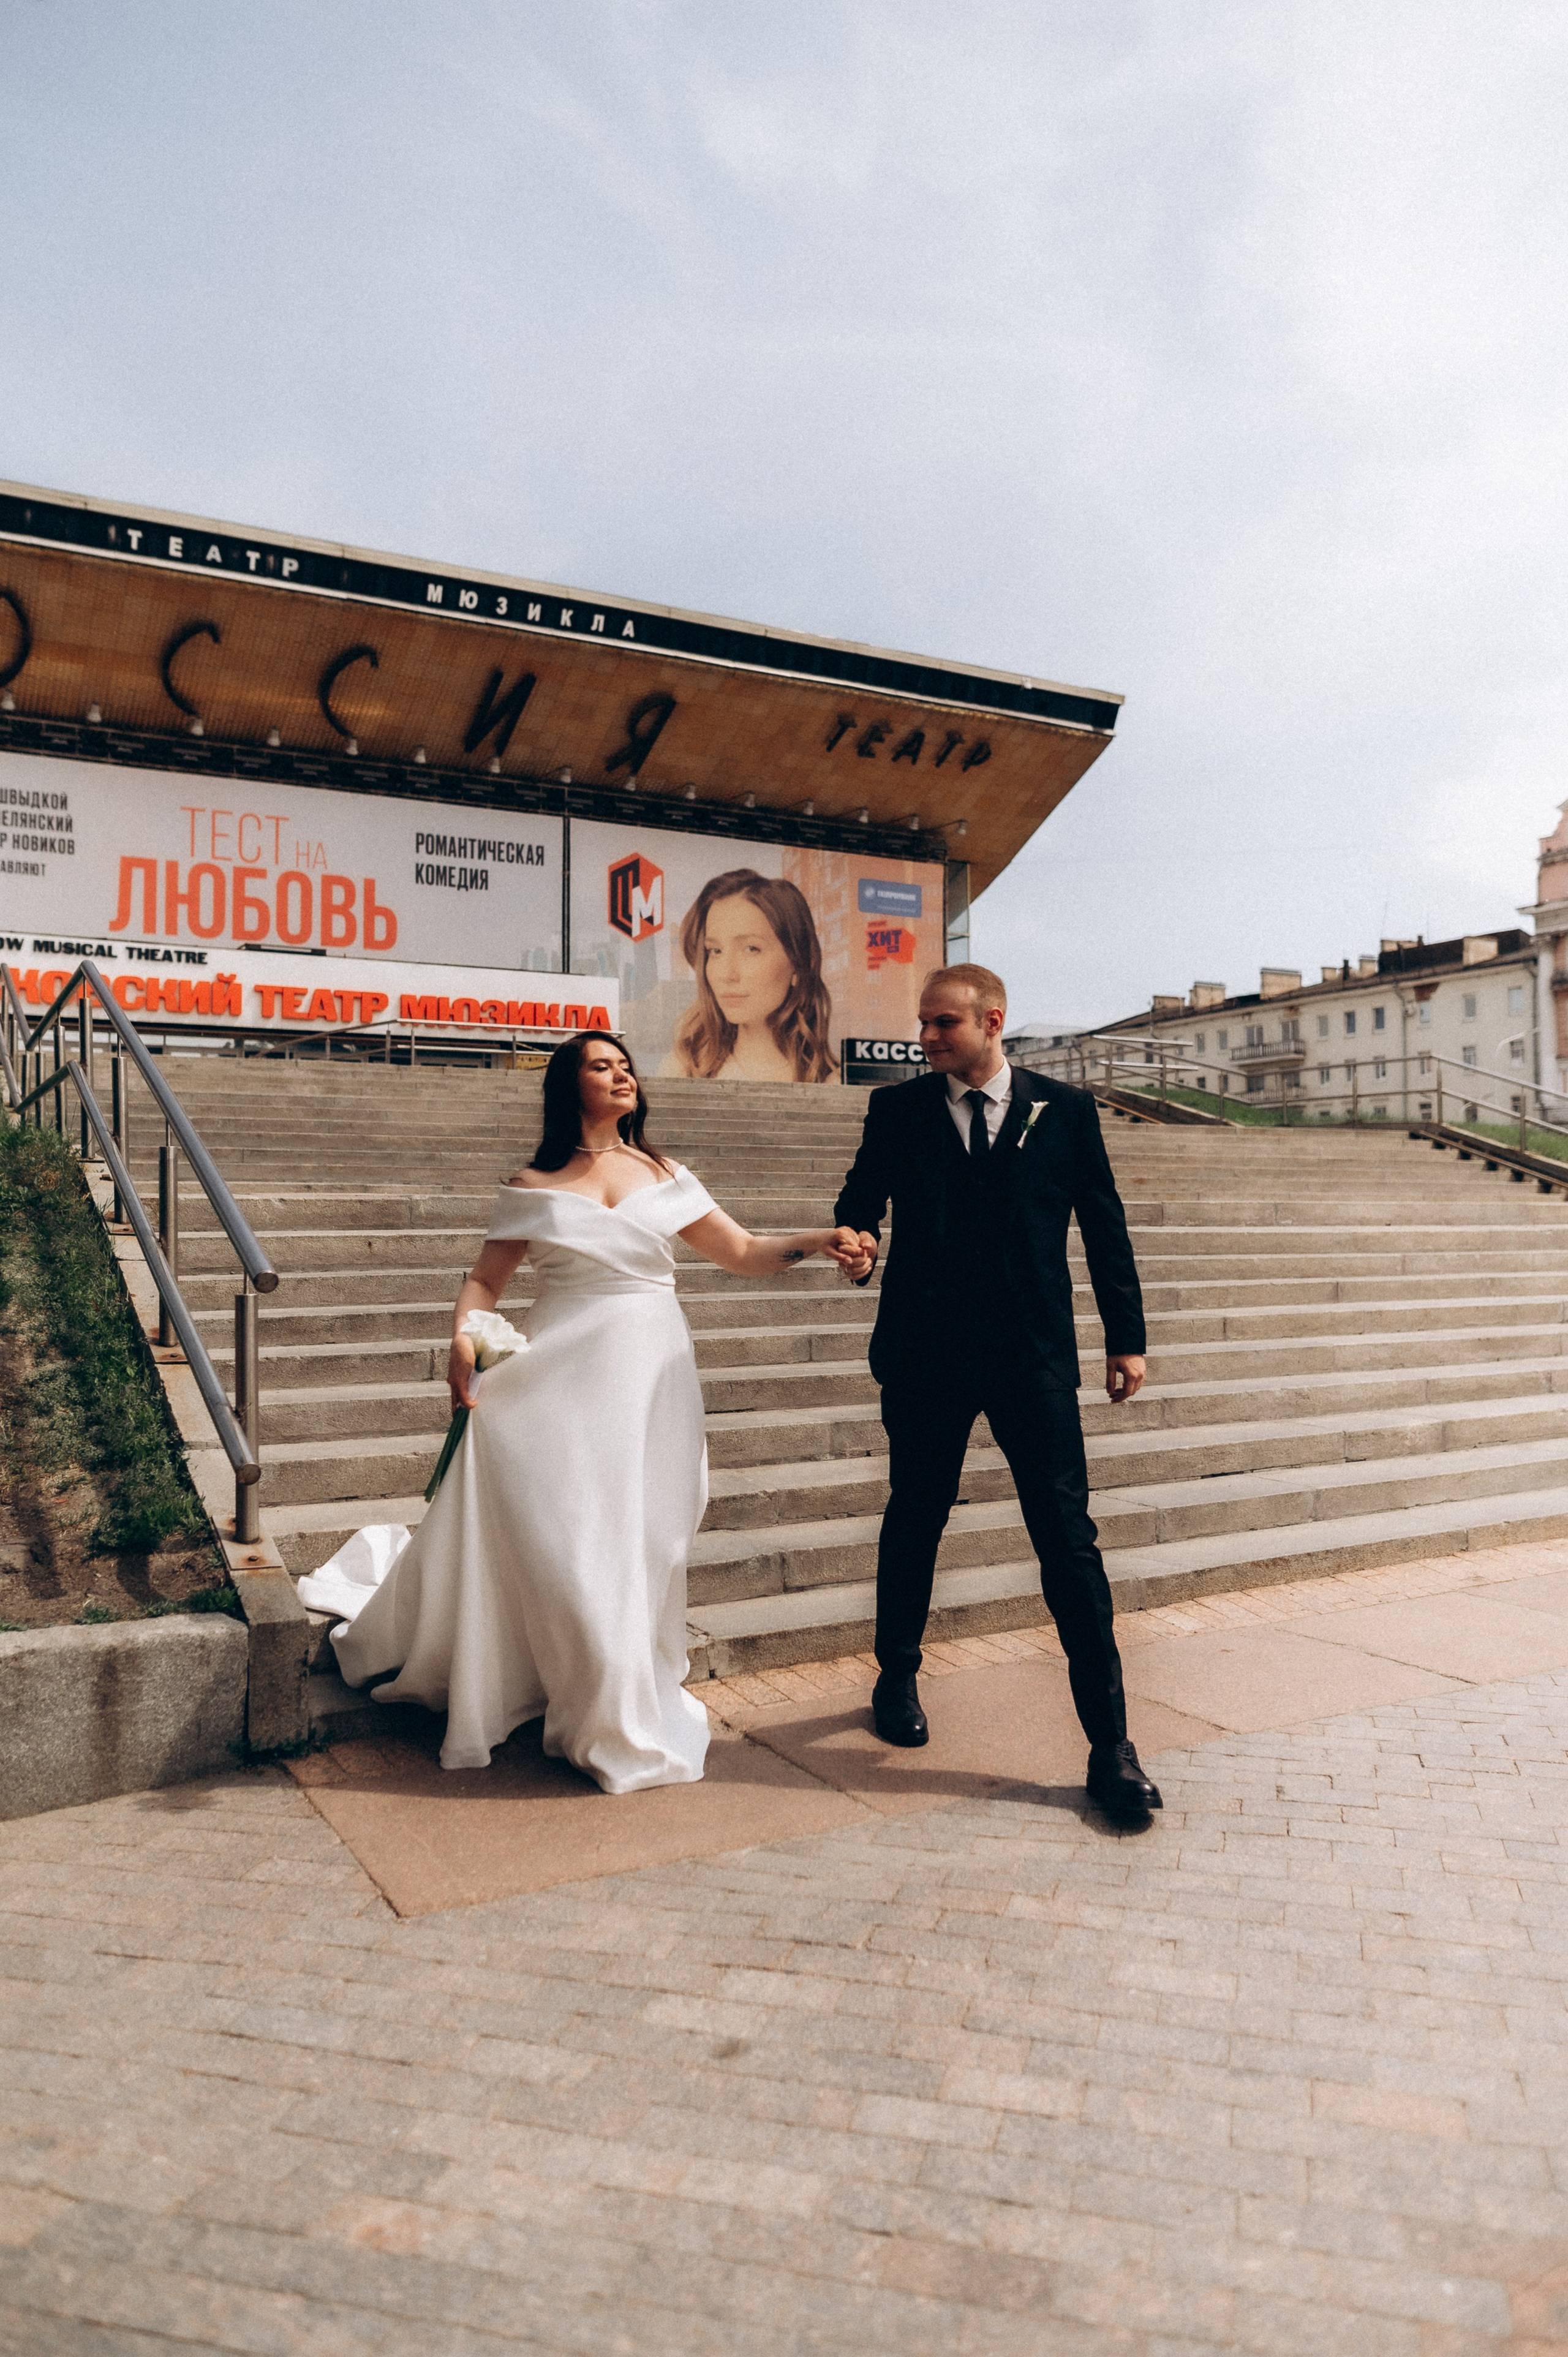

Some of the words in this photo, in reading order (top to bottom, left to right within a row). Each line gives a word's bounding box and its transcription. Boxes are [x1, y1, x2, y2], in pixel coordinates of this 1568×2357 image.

[127, 529, 299, 578] ТЕАТР
[427, 583, 635, 638] МЮЗИКЛА
[824, 712, 992, 773] ТЕАТР
[12, 834, 75, 855] НОВИКОВ
[180, 805, 290, 865] ТЕСТ
[295, 840, 328, 870] НА
[415, 832, 545, 867] РОМАНТИЧЕСКАЯ
[415, 862, 489, 892] КОМЕДИЯ
[108, 855, 398, 951] ЛЮБОВЬ
[33, 939, 118, 959] MUSICAL
[126, 946, 208, 965] THEATRE
[867, 929, 902, 947] ХИТ
[0, 967, 242, 1016] КОСКИЙ
[254, 984, 389, 1024] ТЕАТР
[399, 994, 612, 1035] МЮЗИКЛА
[855, 1041, 931, 1063] касс
